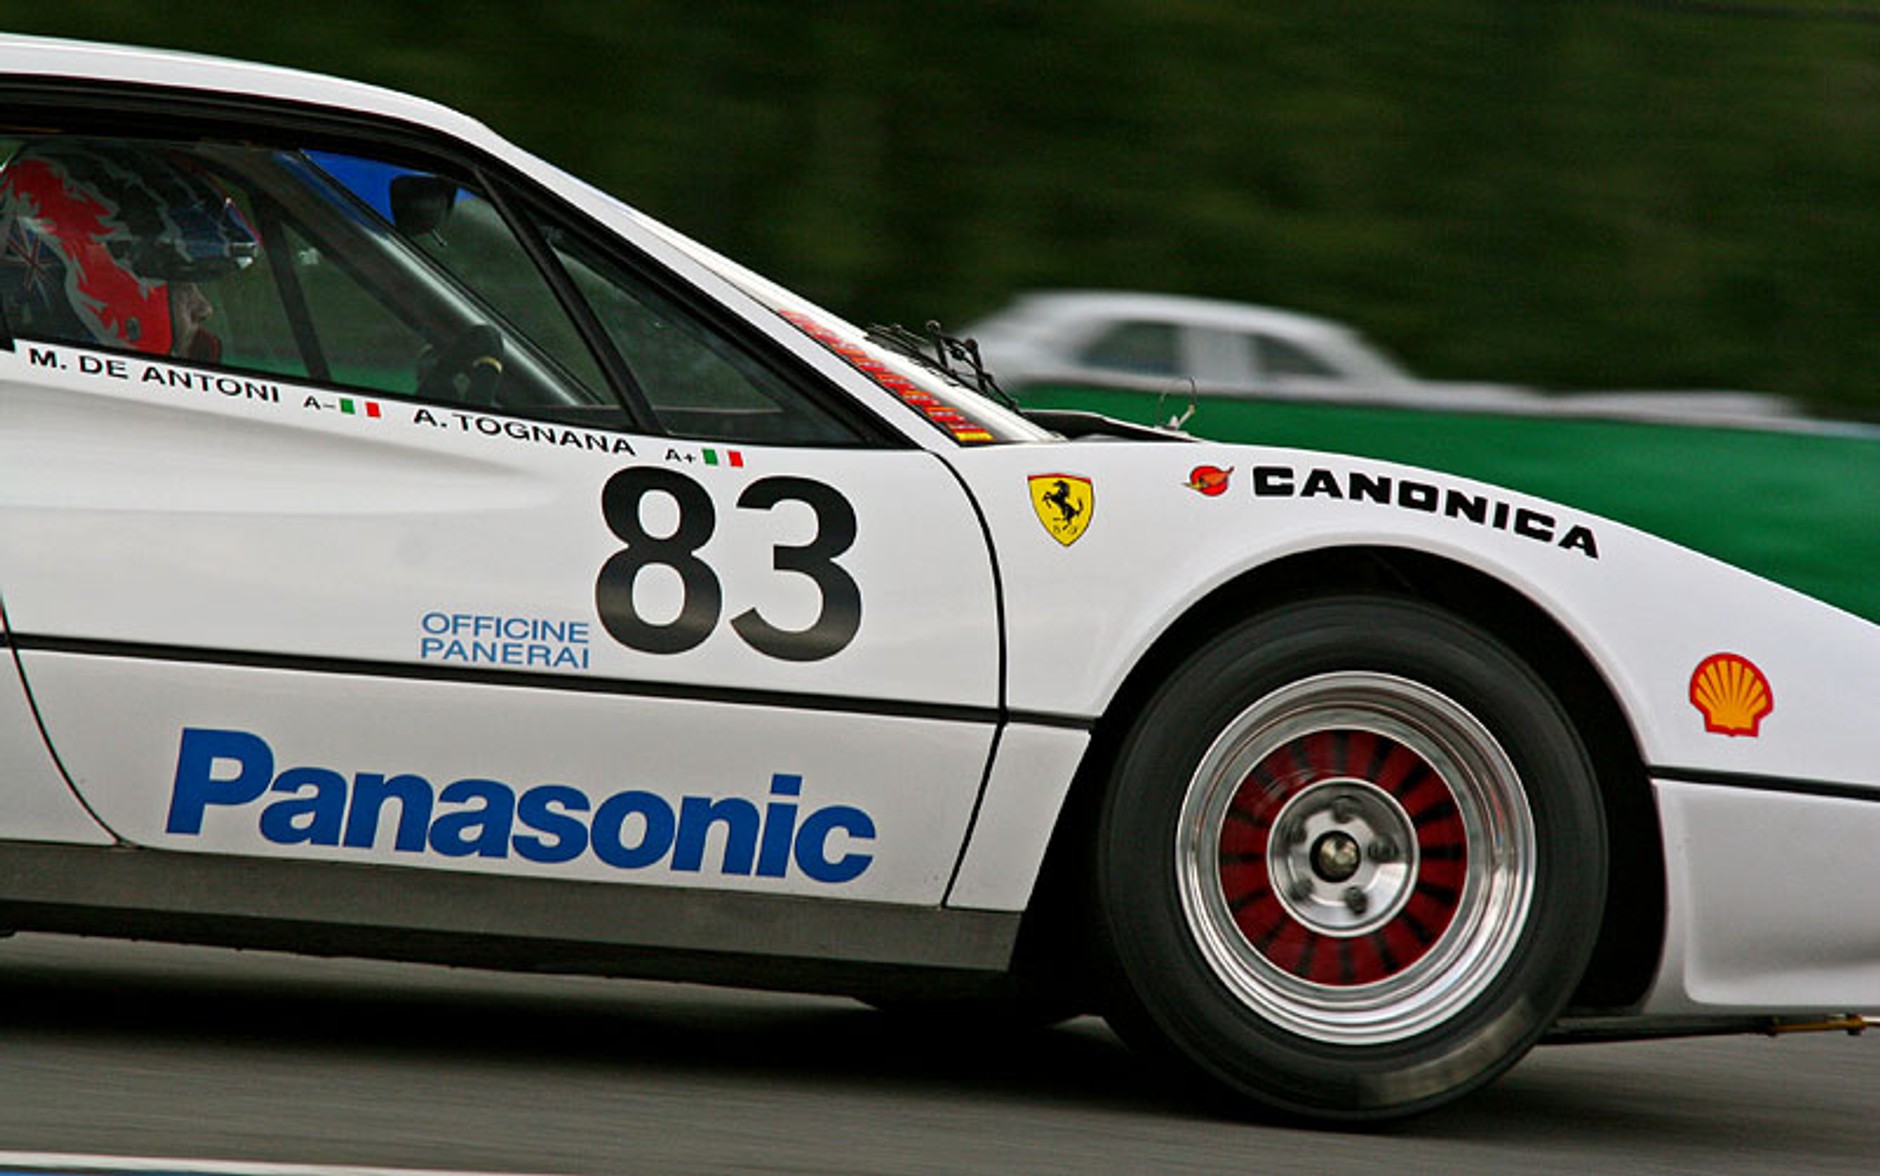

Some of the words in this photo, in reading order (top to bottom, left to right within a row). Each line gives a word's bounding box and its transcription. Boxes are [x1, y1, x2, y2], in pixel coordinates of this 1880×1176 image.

[28, 347, 67, 370] M.
[78, 355, 129, 379] DE
[141, 366, 280, 403] ANTONI
[665, 448, 696, 464] A+
[1252, 465, 1599, 560] CANONICA
[595, 465, 862, 663] 83
[421, 612, 590, 645] OFFICINE
[421, 637, 589, 670] PANERAI
[165, 726, 877, 885] Panasonic
